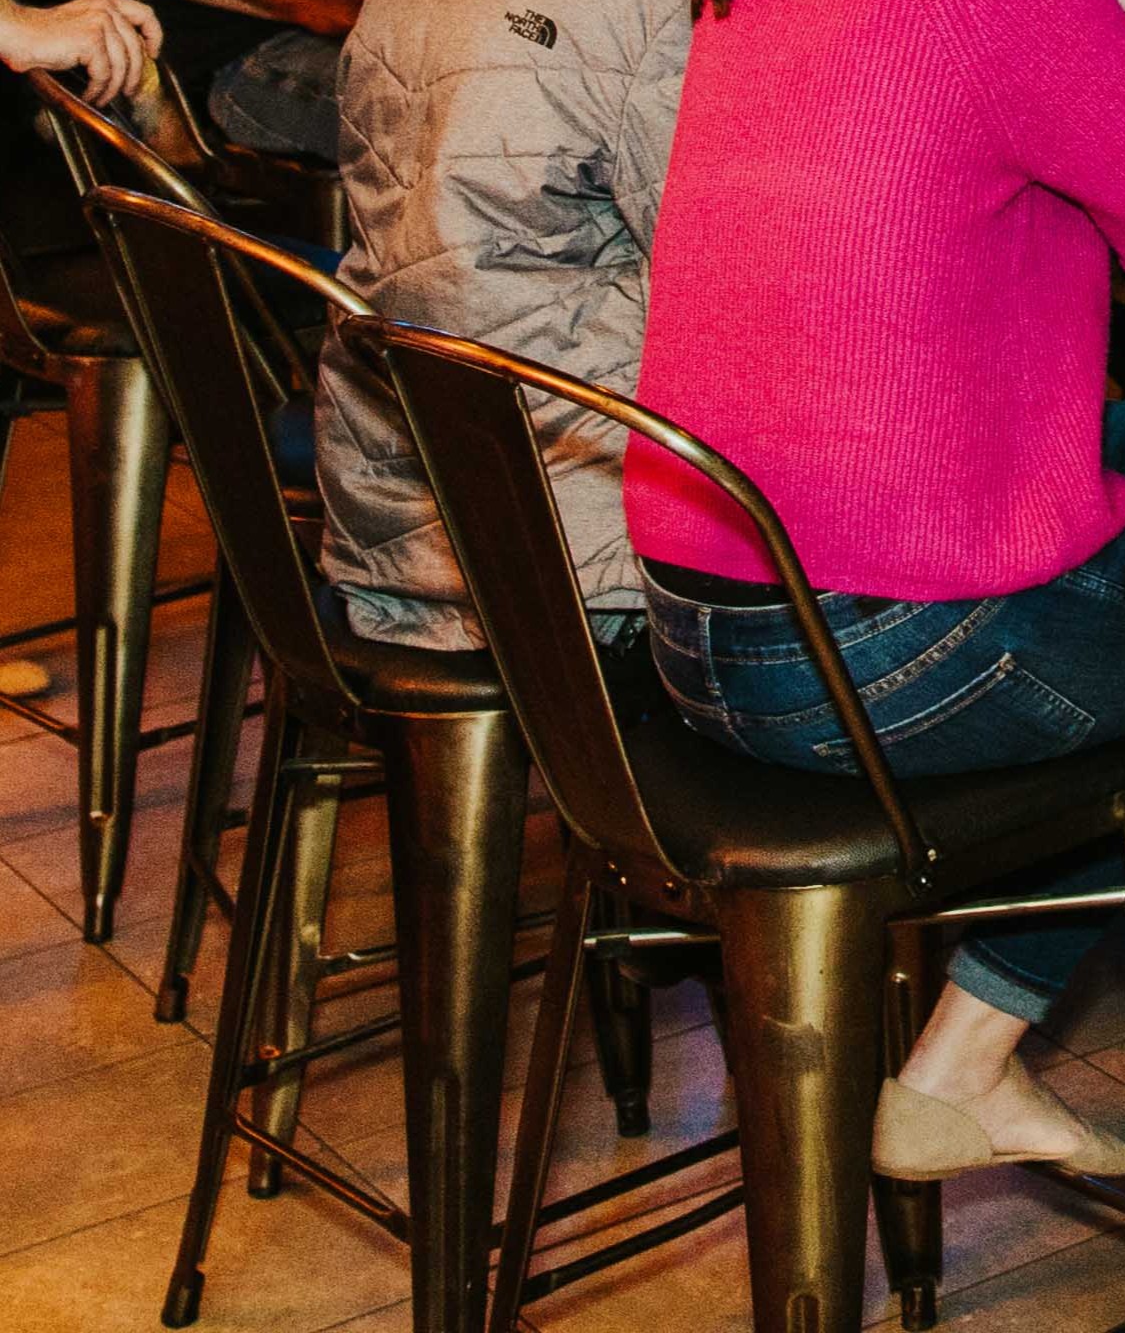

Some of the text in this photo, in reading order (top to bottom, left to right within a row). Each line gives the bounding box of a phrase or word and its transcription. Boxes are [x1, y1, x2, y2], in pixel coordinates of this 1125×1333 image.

[504, 11, 541, 32] NORTH
[525, 9, 546, 25] THE
[509, 23, 538, 42] FACE
